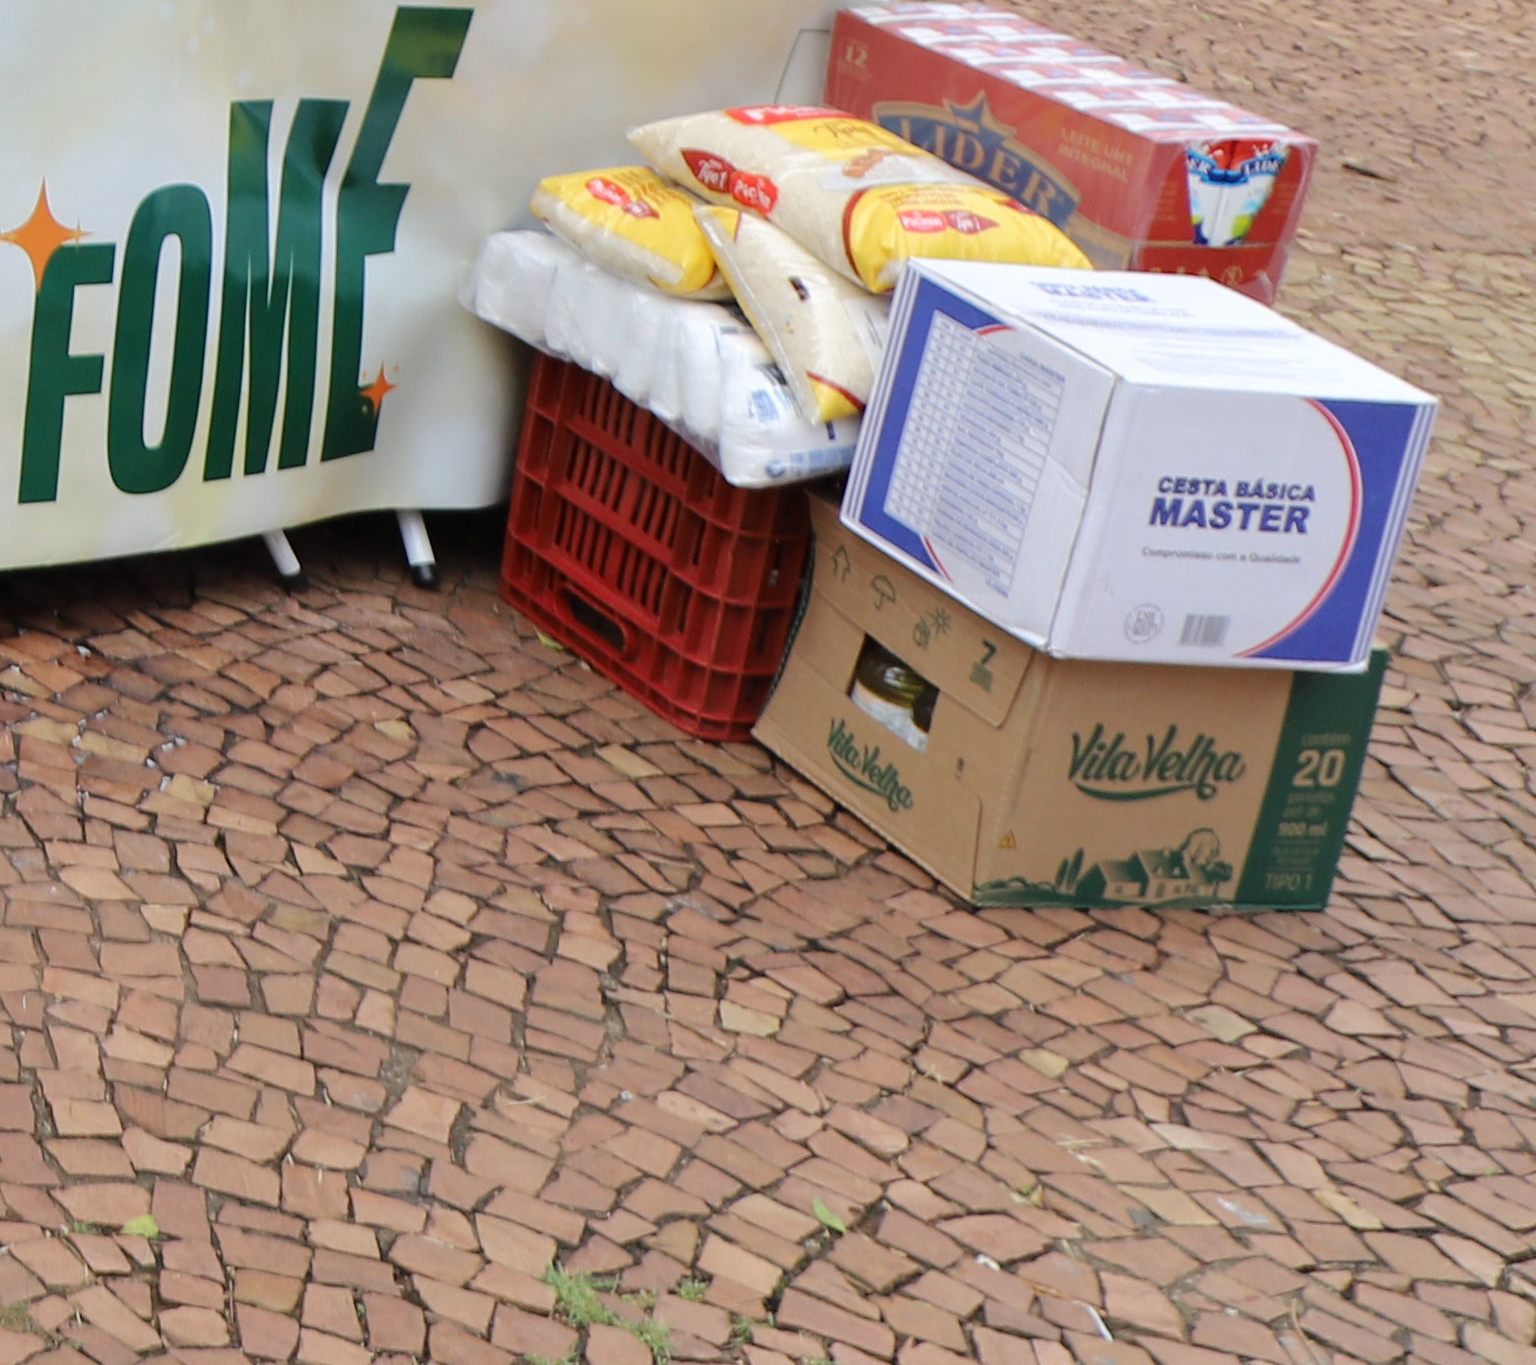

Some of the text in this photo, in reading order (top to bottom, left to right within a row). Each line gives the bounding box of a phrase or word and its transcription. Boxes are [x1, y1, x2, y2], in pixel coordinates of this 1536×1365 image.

[899, 117, 1063, 219] LIDER
[20, 6, 471, 502] FOME
[1148, 496, 1312, 534] MASTER
[1157, 476, 1317, 502] CESTA BÁSICA
[981, 640, 997, 664] 7
[827, 717, 914, 813] Vila Velha
[1068, 722, 1247, 800] Vila Velha
[1293, 748, 1346, 788] 20
